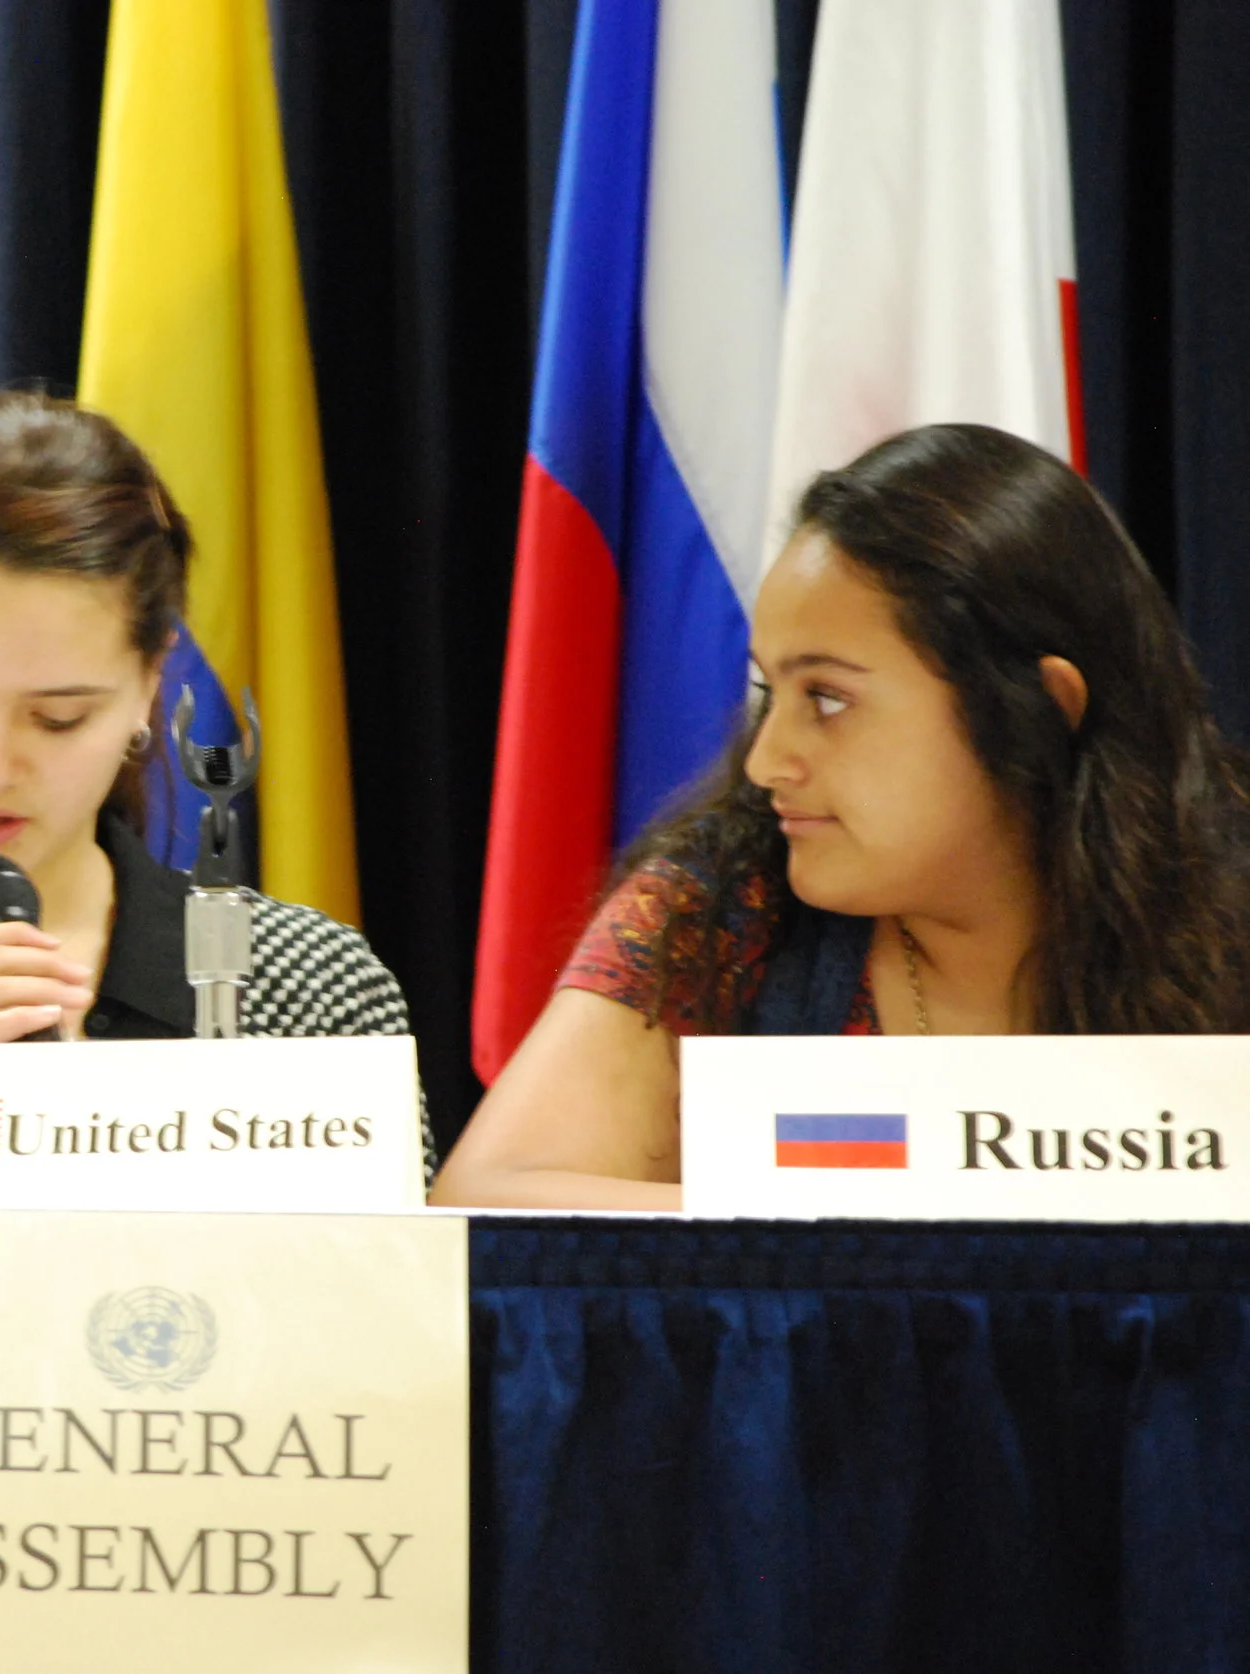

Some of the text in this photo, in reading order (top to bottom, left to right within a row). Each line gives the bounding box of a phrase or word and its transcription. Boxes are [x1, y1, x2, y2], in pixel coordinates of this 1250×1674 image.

[8, 1109, 372, 1156] United States
[958, 1110, 1227, 1171] Russia
